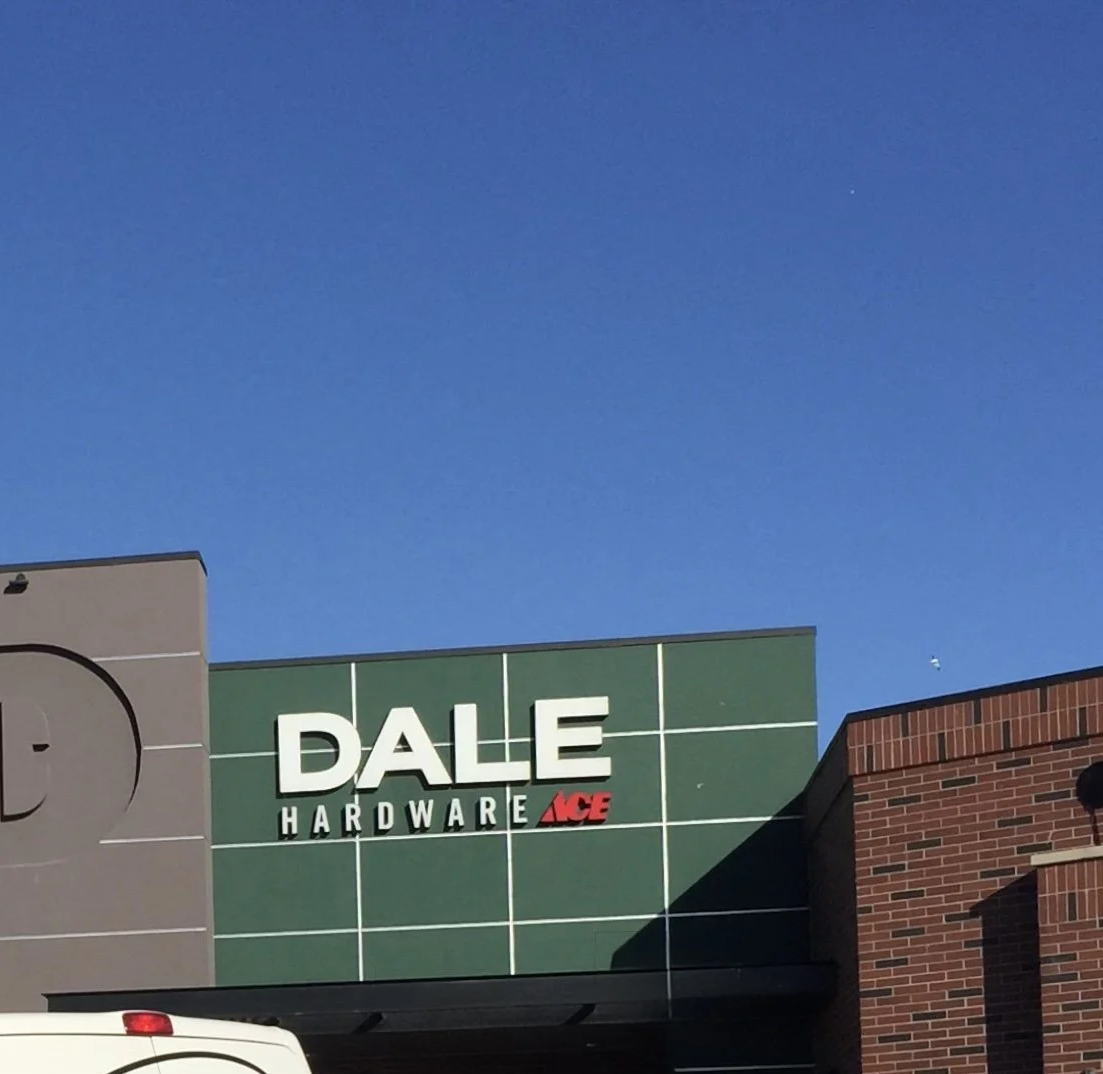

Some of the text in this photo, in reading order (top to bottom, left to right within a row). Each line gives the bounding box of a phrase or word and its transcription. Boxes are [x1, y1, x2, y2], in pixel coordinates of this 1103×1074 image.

[276, 696, 612, 794] DALE
[280, 790, 613, 837] HARDWARE ACE
